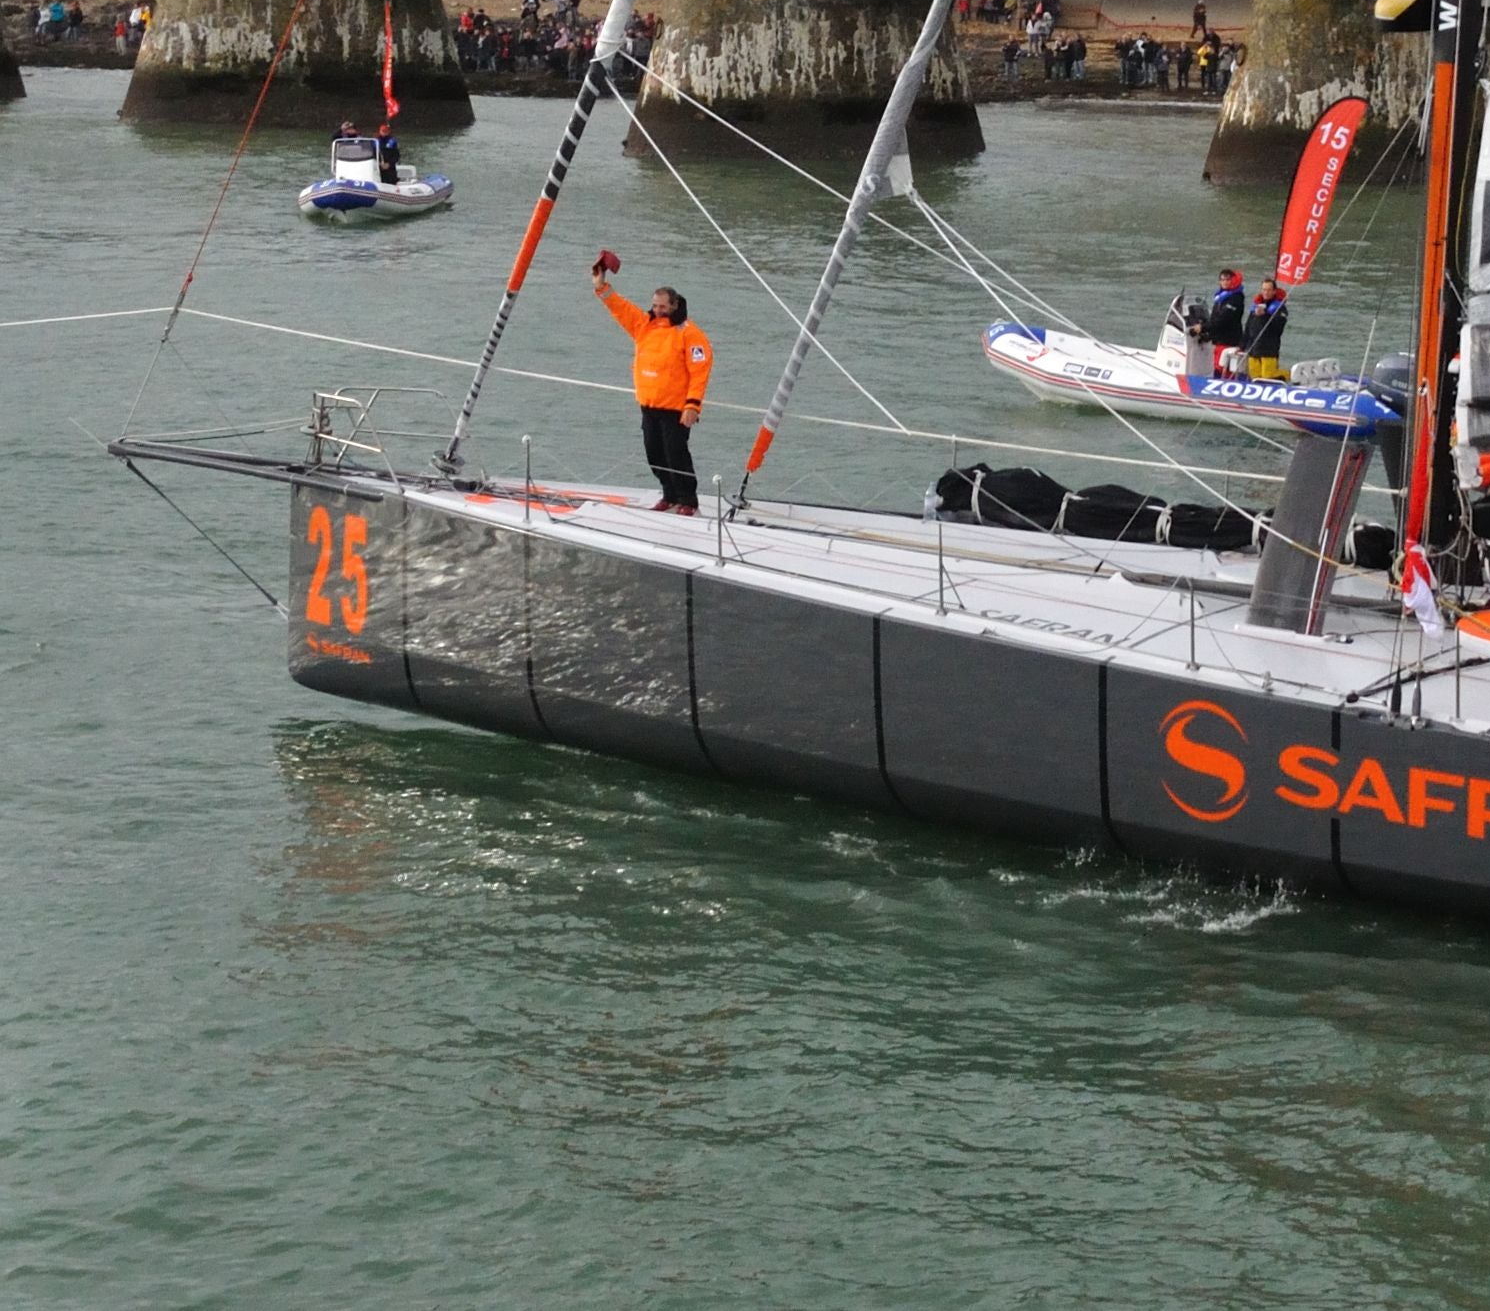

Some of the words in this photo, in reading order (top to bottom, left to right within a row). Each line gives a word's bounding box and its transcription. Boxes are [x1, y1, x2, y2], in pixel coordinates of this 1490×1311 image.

[1319, 121, 1351, 150] 15
[1294, 156, 1339, 280] SECURITE
[1201, 378, 1309, 406] ZODIAC
[305, 504, 369, 635] 25
